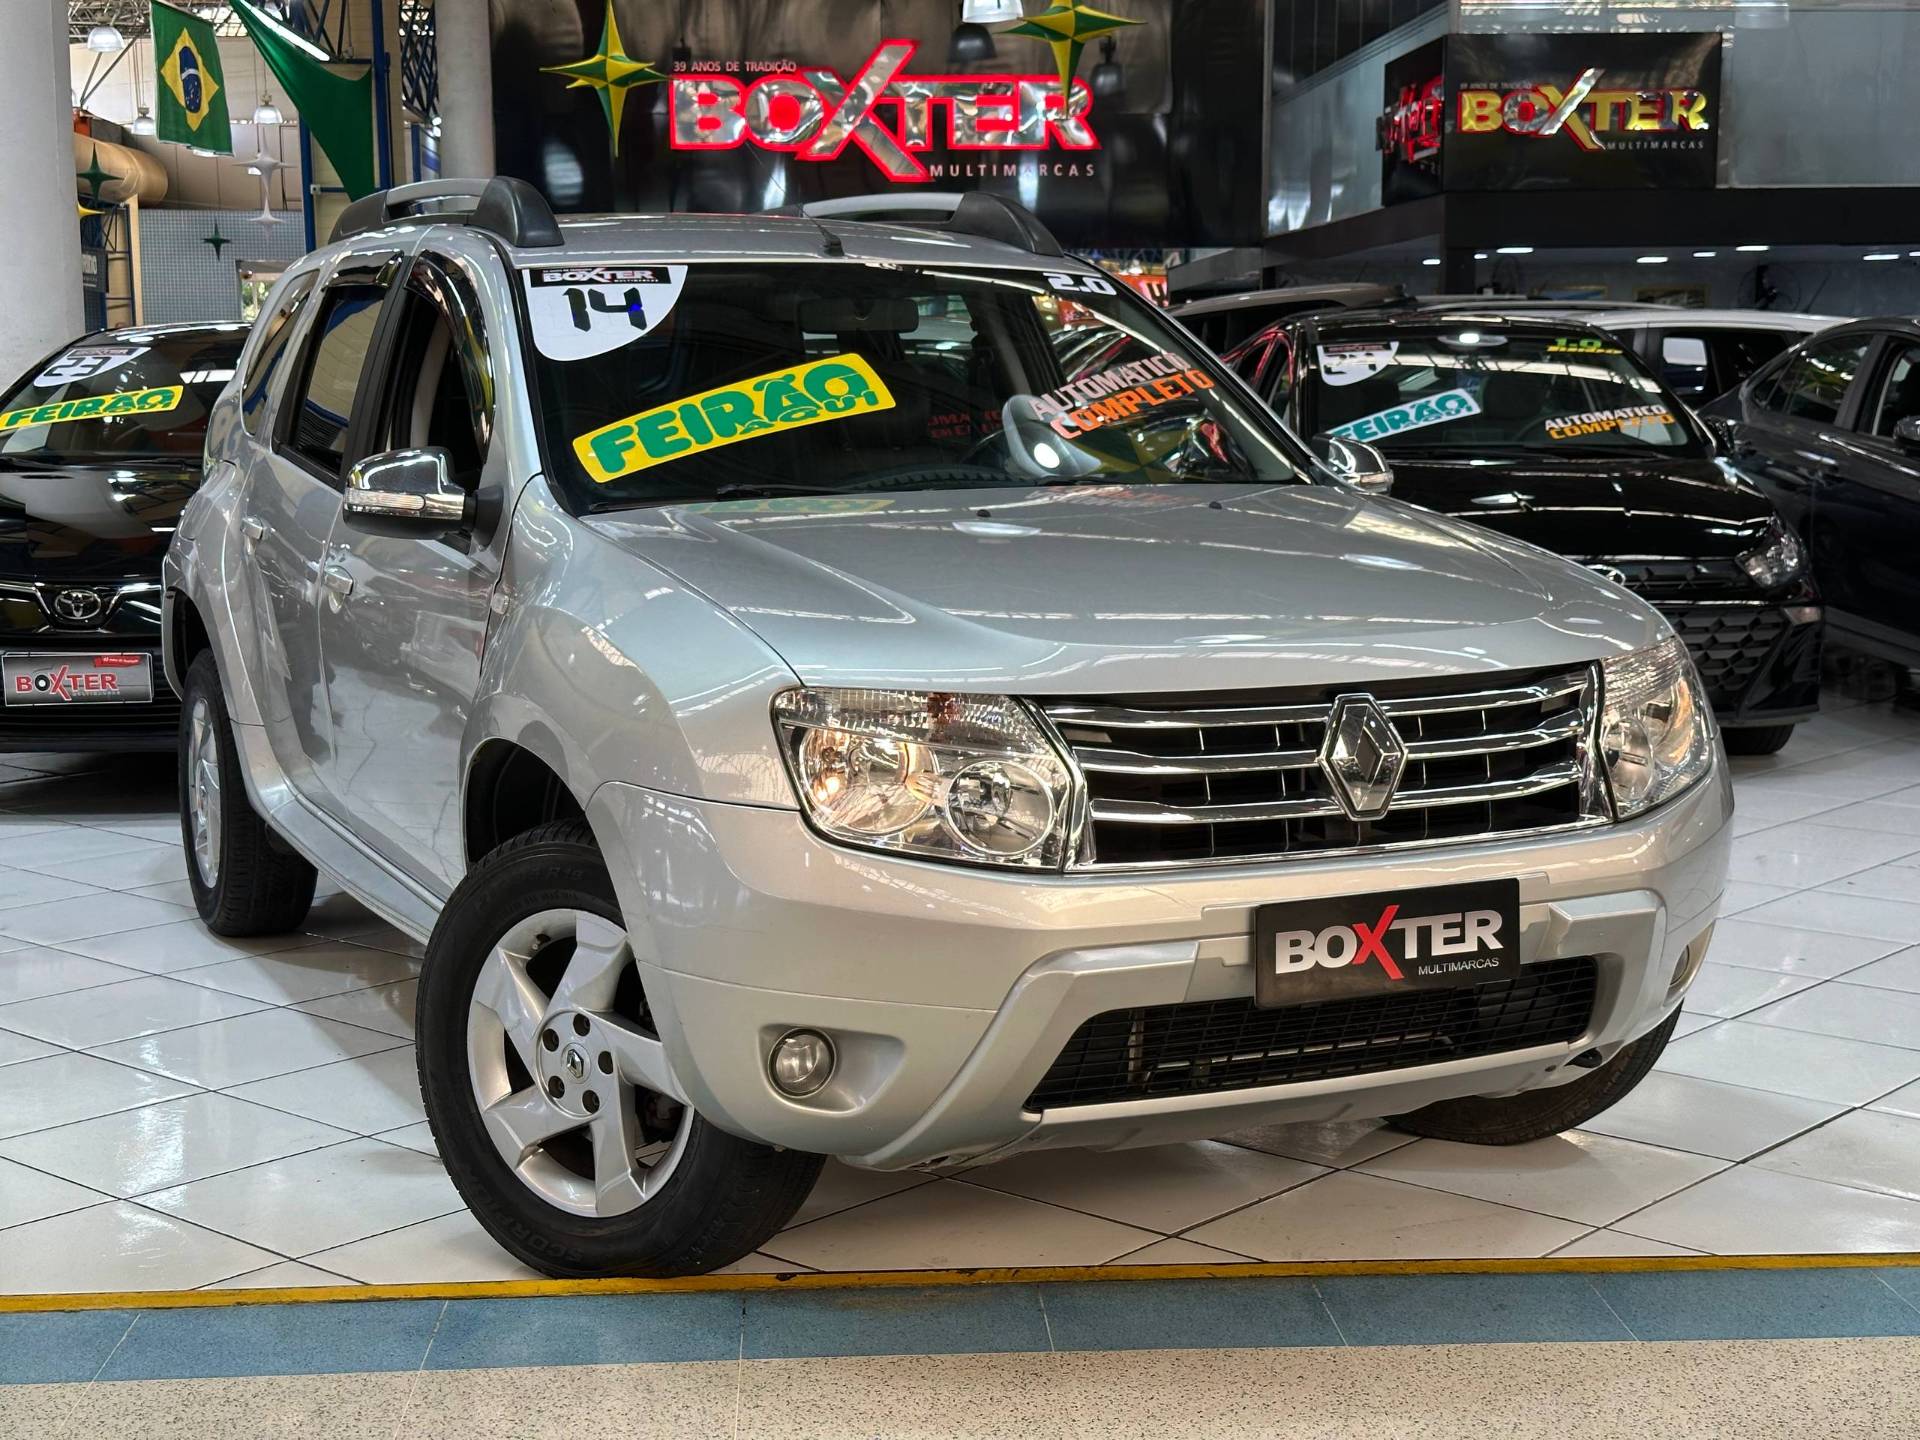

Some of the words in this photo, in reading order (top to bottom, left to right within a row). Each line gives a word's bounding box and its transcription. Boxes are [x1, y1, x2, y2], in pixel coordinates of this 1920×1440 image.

[673, 61, 687, 72] 39
[691, 61, 721, 72] ANOS
[726, 61, 740, 72] DE
[745, 59, 797, 74] TRADIÇÃO
[669, 38, 1102, 183] BOXTER
[1458, 66, 1711, 151] BOXTER
[1607, 140, 1705, 151] MULTIMARCAS
[929, 163, 1095, 177] MULTIMARCAS
[543, 267, 655, 283] BOXTER
[1043, 272, 1117, 296] 2.0
[562, 287, 648, 332] 14
[590, 363, 869, 474] FEIRÃO
[1050, 368, 1216, 440] COMPLETO
[15, 664, 119, 701] BOXTER
[1275, 904, 1504, 981] BOXTER
[1418, 956, 1499, 976] MULTIMARCAS
